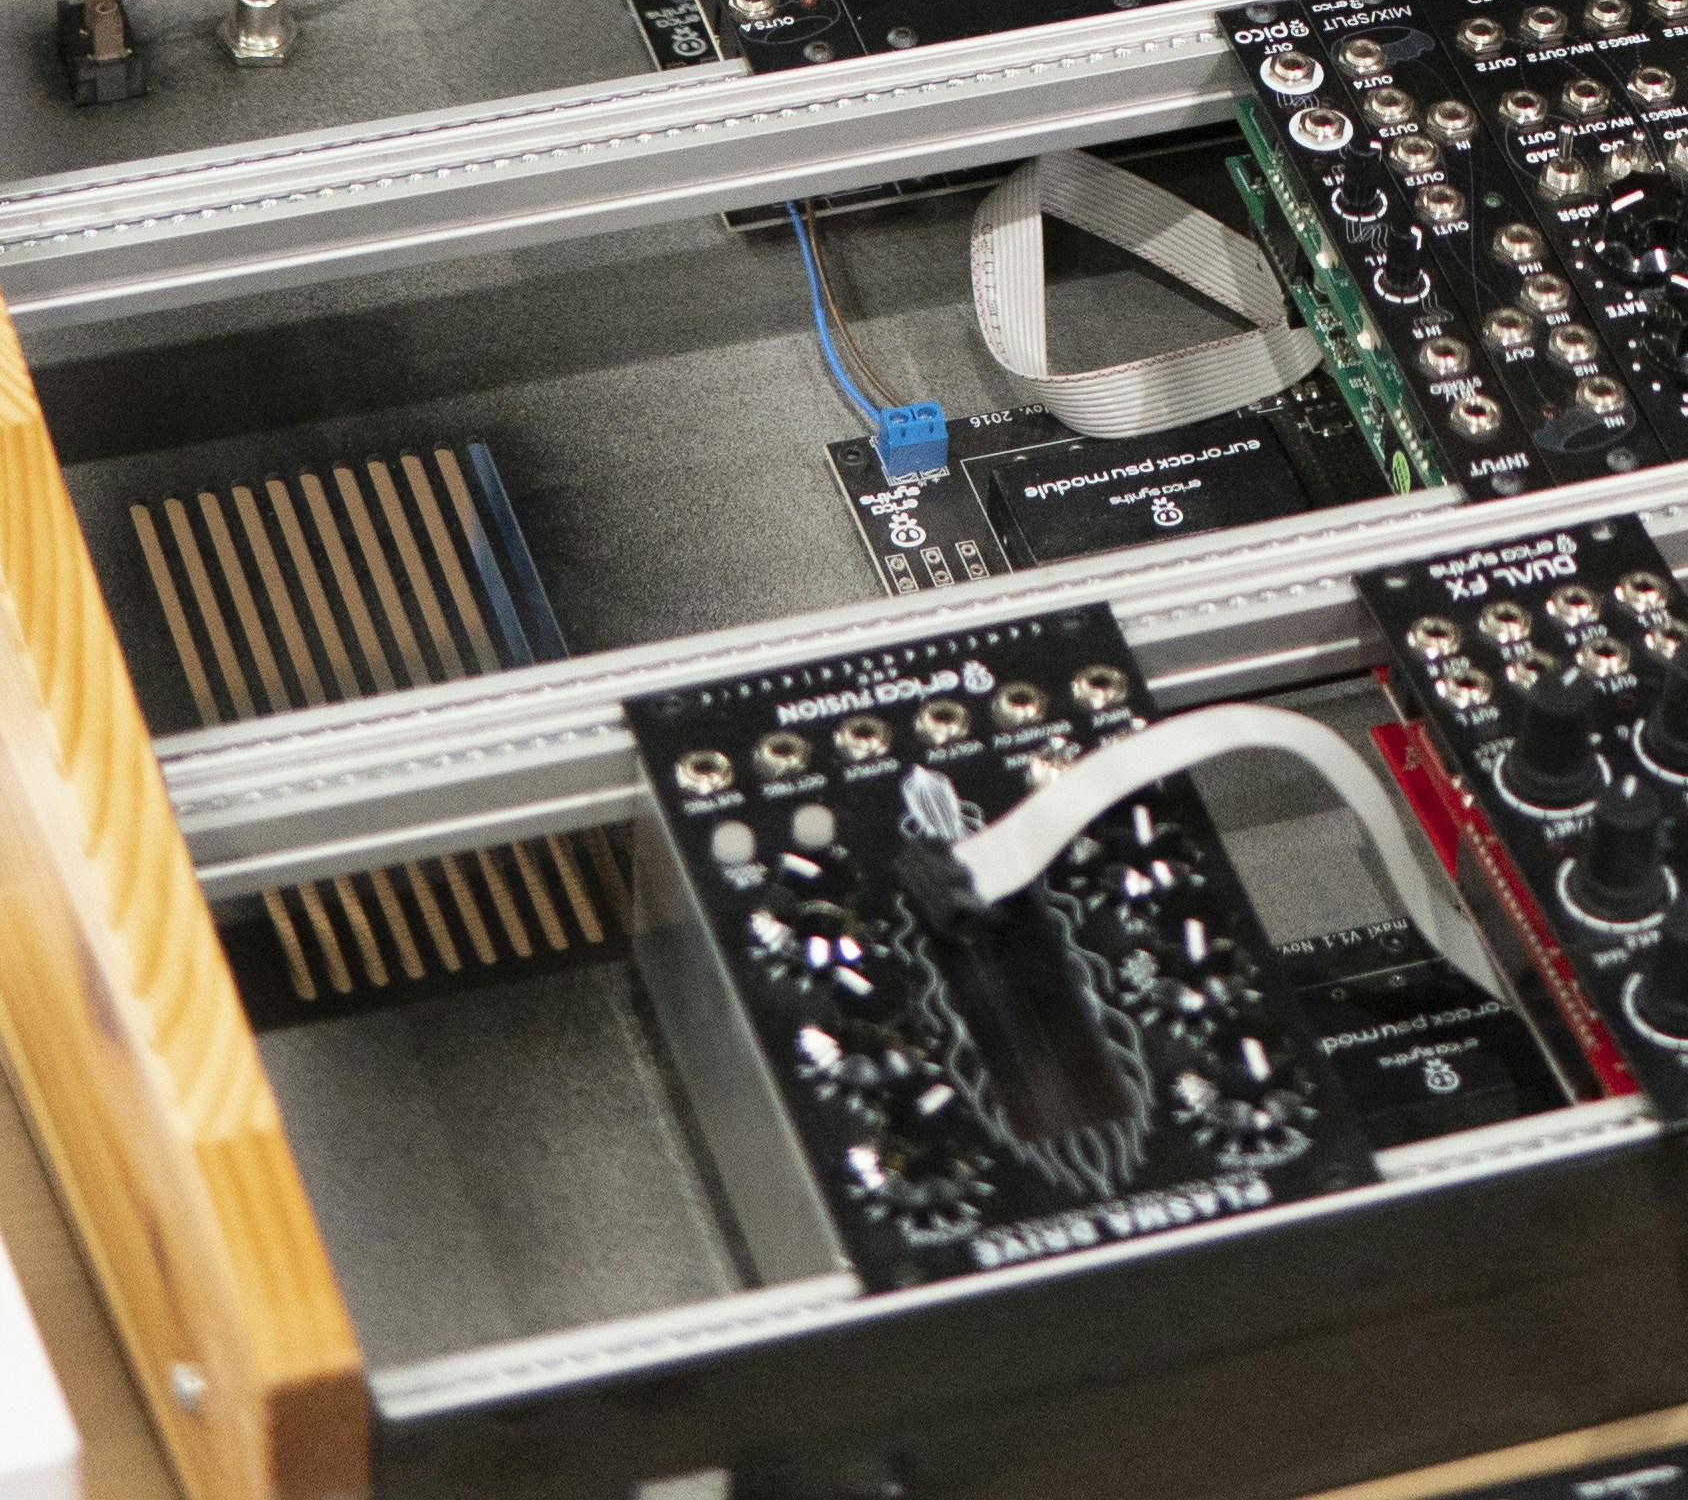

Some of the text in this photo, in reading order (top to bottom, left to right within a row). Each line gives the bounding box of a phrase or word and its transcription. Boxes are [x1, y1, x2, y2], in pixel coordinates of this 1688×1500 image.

[1312, 0, 1347, 12] erica
[755, 16, 794, 28] OUTS
[1323, 5, 1412, 32] MIX/SPLIT
[1235, 21, 1288, 44] pico
[1265, 42, 1293, 54] OUT
[1378, 124, 1419, 138] OUT3
[1455, 140, 1471, 151] IN
[1404, 171, 1444, 187] OUT2
[1432, 221, 1469, 236] OUT1
[1605, 299, 1648, 318] RATE
[1505, 347, 1535, 362] OUT
[969, 410, 1013, 428] 2016
[1024, 438, 1261, 500] eurorack psu module
[1470, 452, 1529, 477] INPUT
[858, 485, 920, 507] synths
[1109, 478, 1202, 505] erica synths
[870, 499, 918, 515] erica
[1500, 541, 1553, 562] erica
[1445, 554, 1577, 601] DUAL FX
[775, 671, 959, 725] erica FUSION
[1276, 919, 1408, 955] maxi V1.1 Nov.
[972, 1180, 1273, 1267] PLASMA DRIVE
